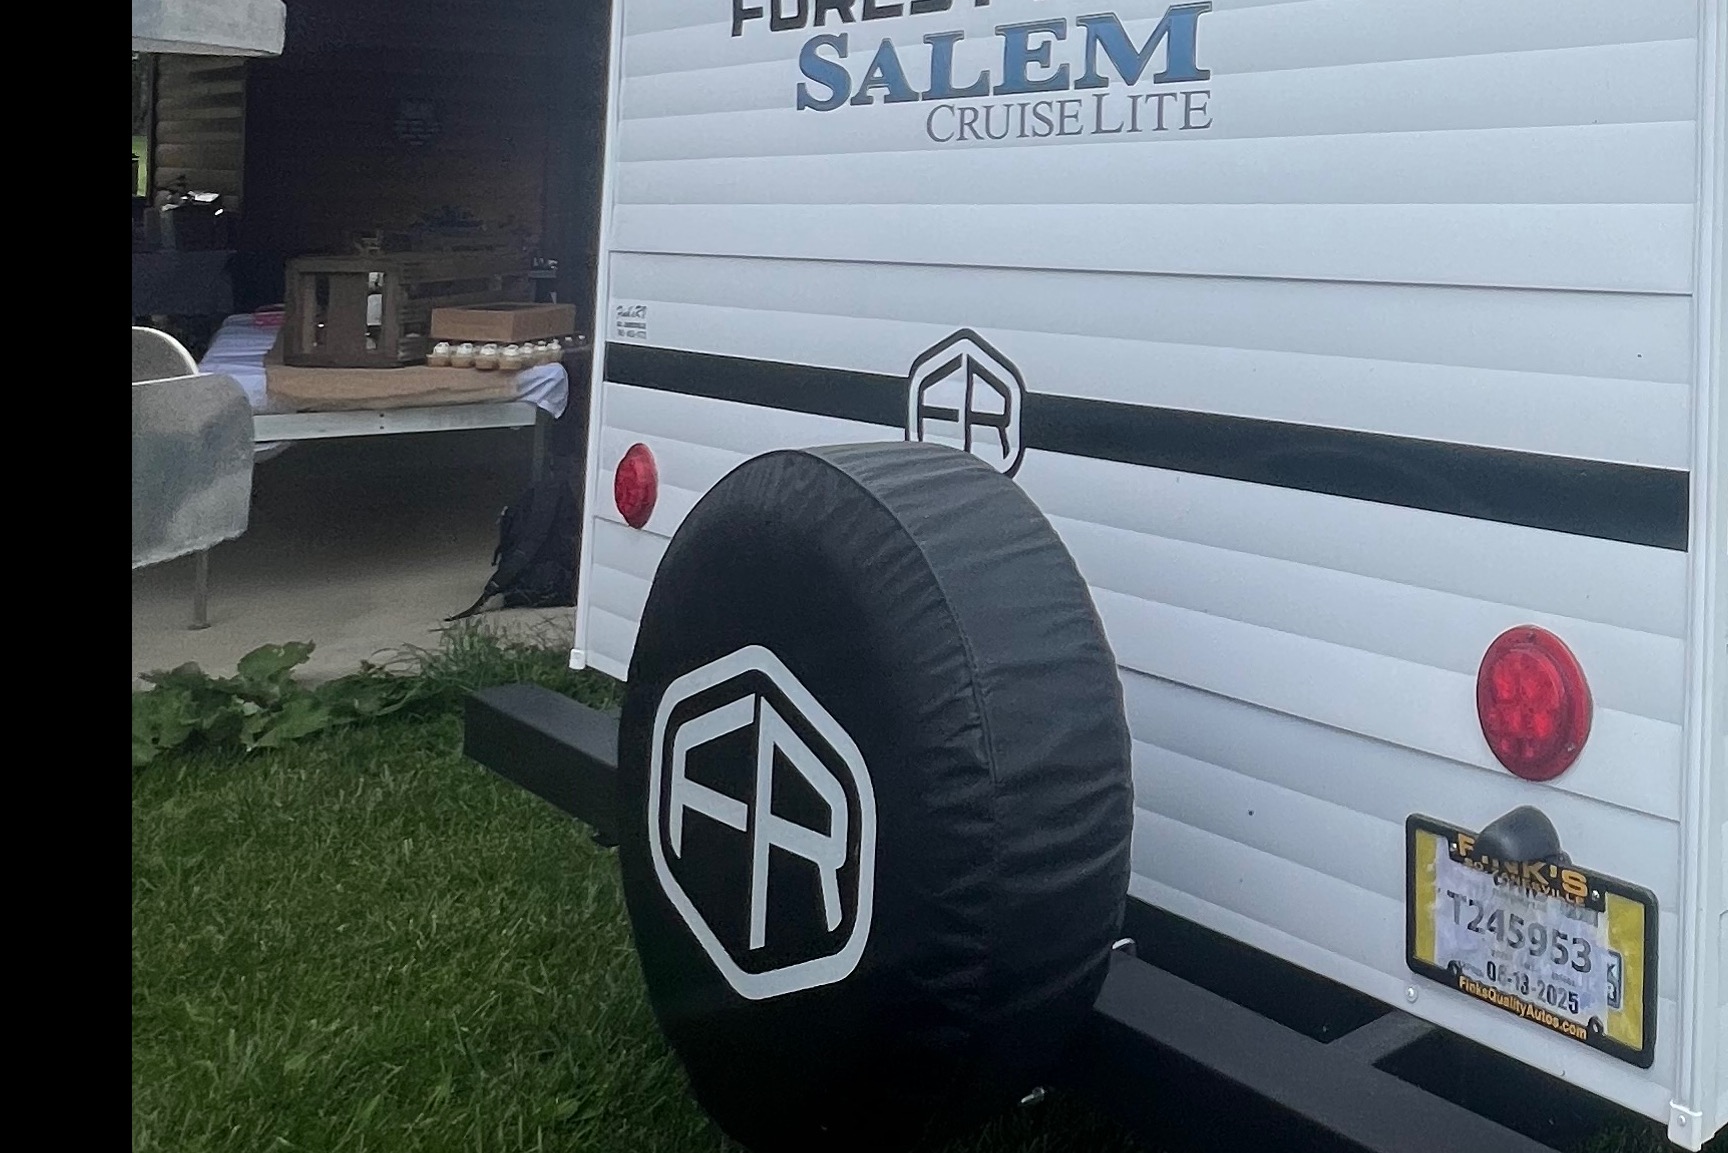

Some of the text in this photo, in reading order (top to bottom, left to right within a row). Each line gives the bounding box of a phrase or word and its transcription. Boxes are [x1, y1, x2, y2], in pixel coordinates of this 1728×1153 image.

[797, 1, 1213, 112] SALEM
[926, 91, 1213, 143] CRUISE LITE
[1447, 890, 1593, 974] T245953
[1458, 975, 1588, 1041] FinksQualityAutos.com
